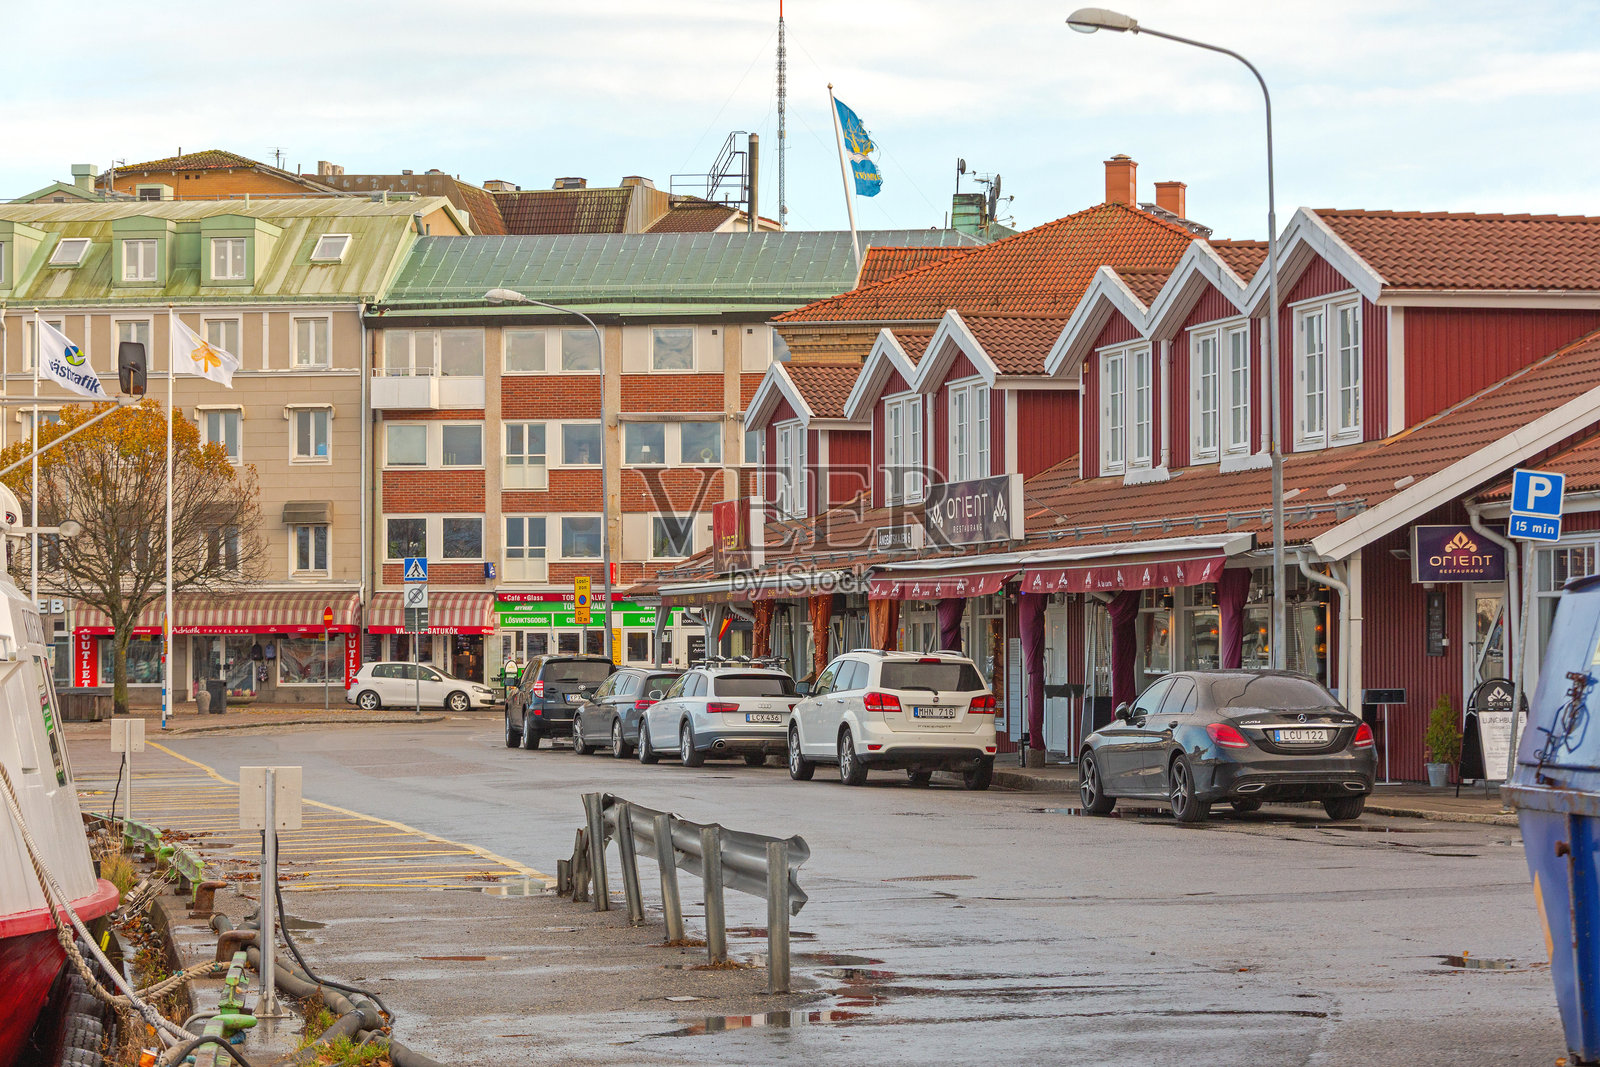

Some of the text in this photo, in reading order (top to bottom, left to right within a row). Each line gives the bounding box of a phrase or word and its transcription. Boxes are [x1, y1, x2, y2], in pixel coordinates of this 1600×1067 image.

[1526, 475, 1553, 510] P
[952, 523, 983, 534] RESTAURANG
[1515, 520, 1555, 535] 15 min
[171, 622, 200, 634] Adriatik
[427, 627, 459, 635] GATUKÖK
[918, 708, 934, 716] MHN
[1283, 730, 1324, 740] LCU 122
